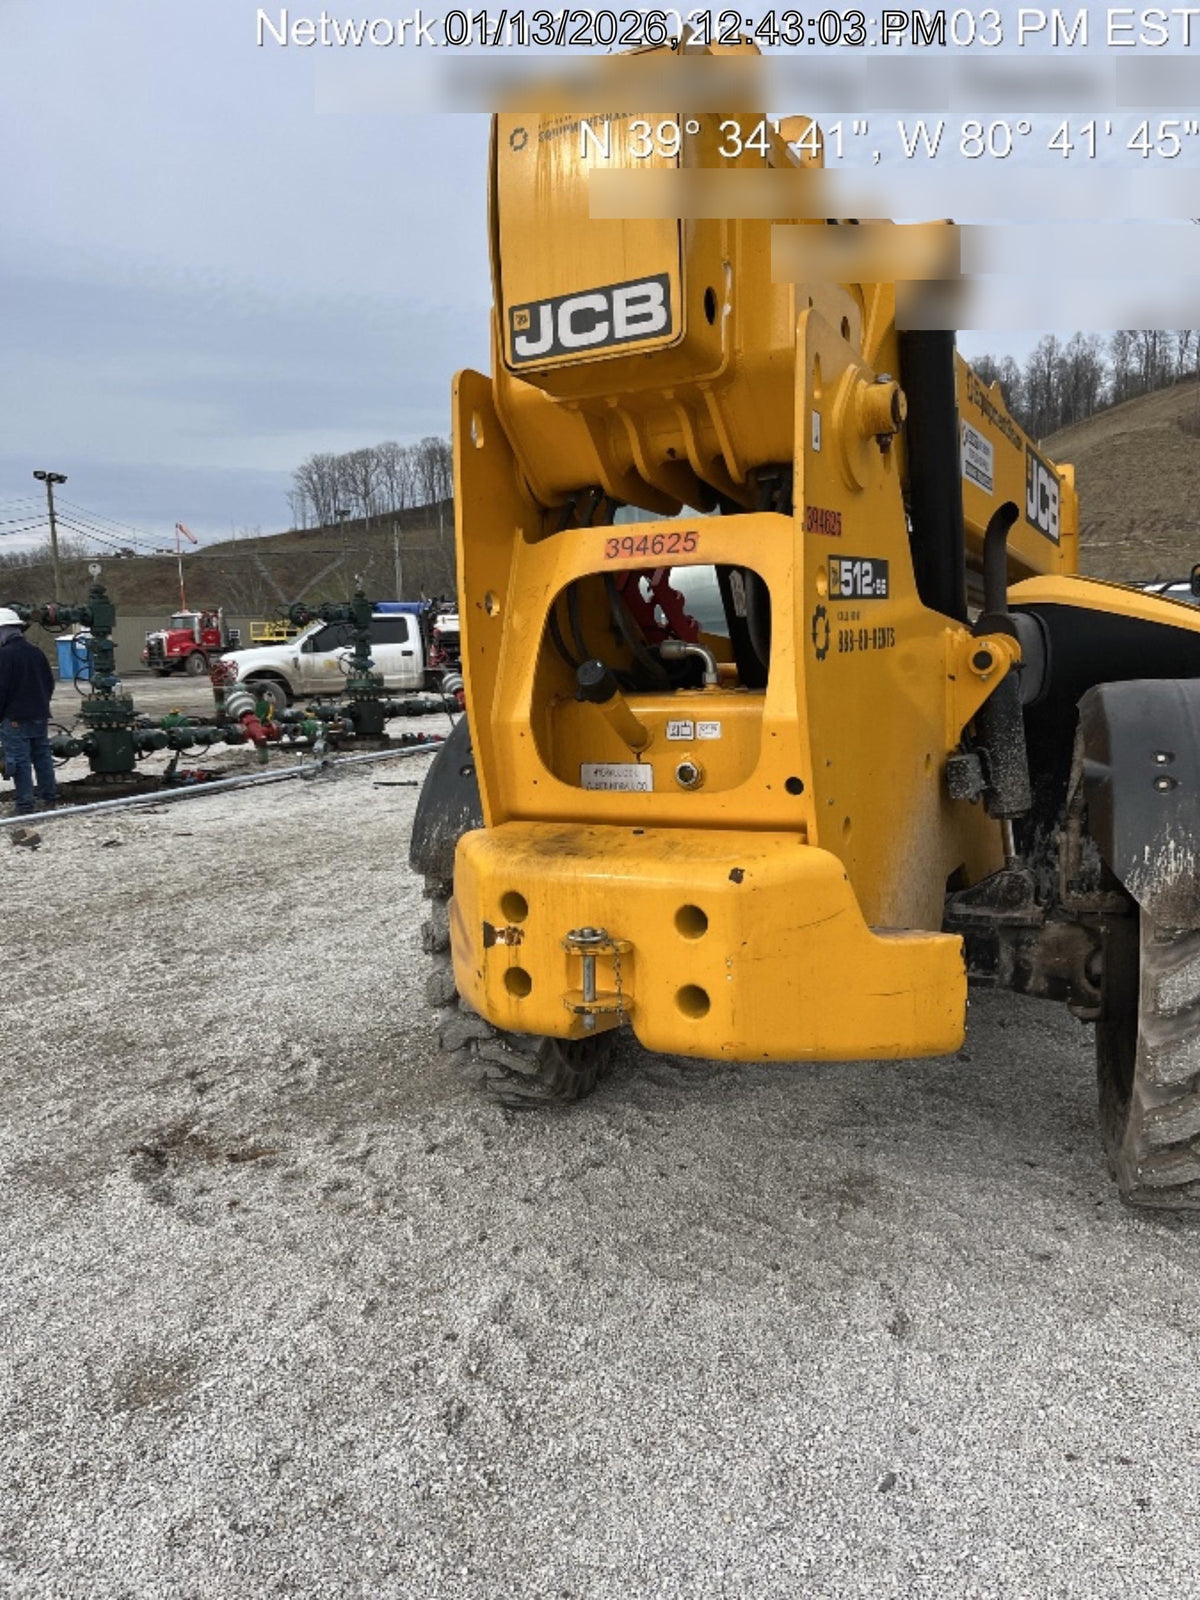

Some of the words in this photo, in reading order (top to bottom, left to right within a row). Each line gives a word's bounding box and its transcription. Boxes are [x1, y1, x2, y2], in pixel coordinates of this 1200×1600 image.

[514, 281, 668, 356] JCB
[806, 505, 842, 537] 394625
[1027, 457, 1059, 540] JCB
[606, 531, 698, 559] 394625
